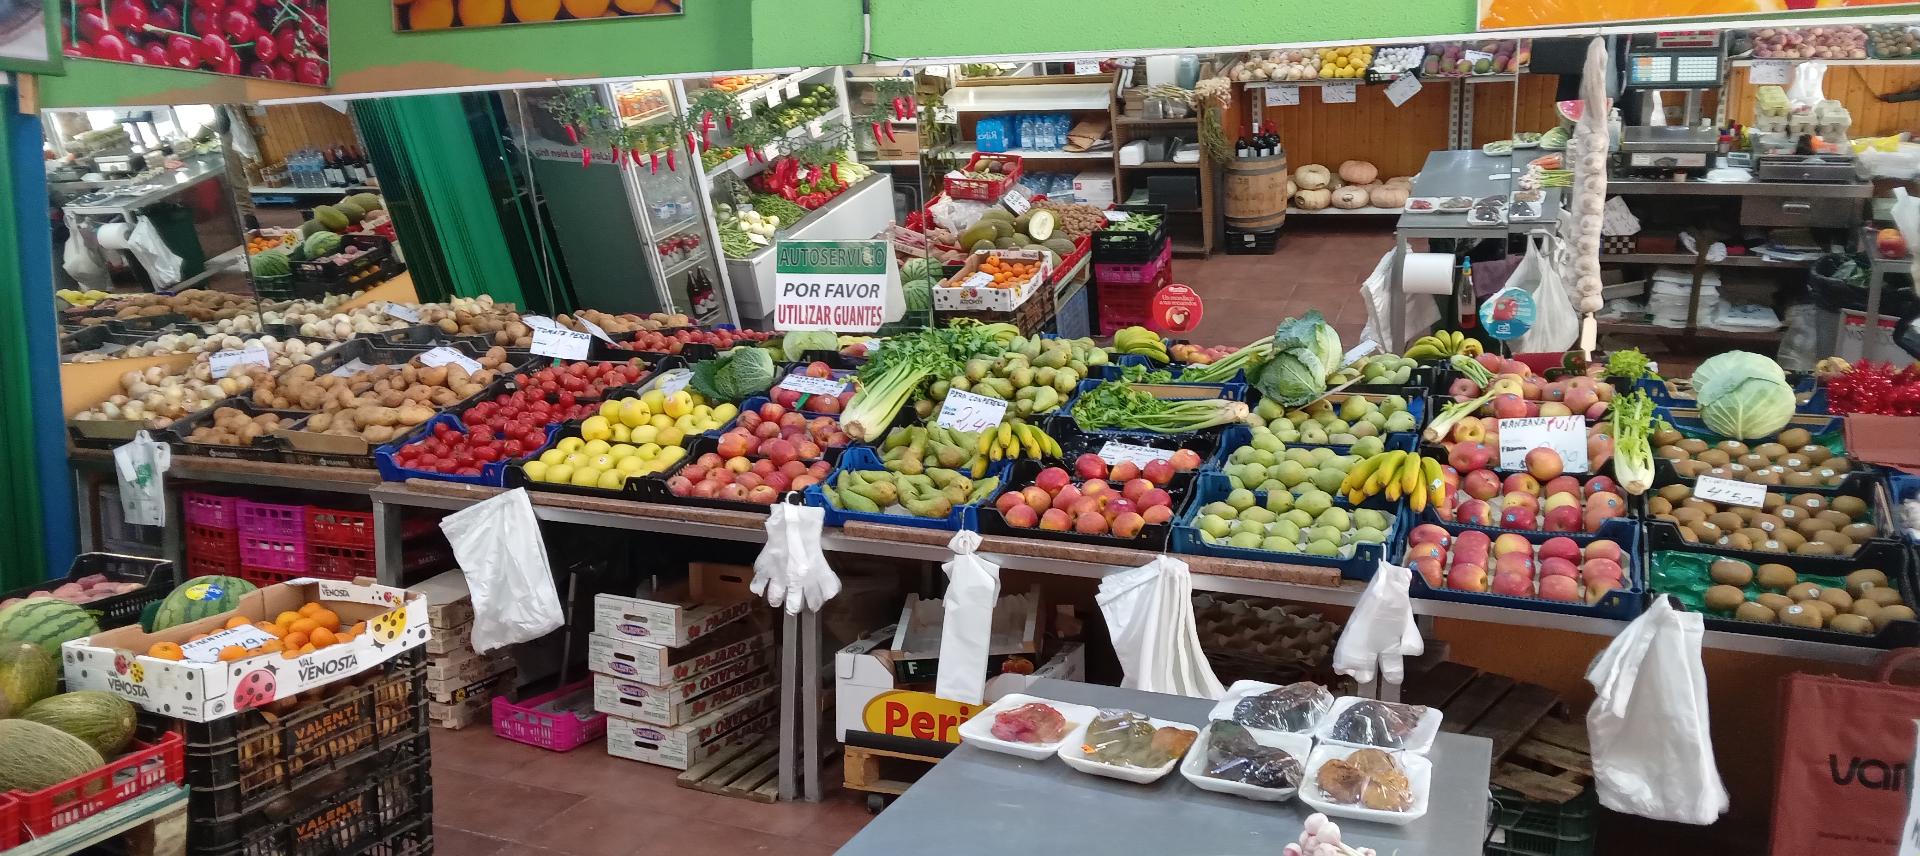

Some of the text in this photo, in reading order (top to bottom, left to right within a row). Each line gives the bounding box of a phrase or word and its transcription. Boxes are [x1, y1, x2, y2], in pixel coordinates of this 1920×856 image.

[780, 247, 885, 267] AUTOSERVICIO
[783, 283, 880, 298] POR FAVOR
[778, 304, 882, 326] UTILIZAR GUANTES
[1501, 418, 1546, 430] MANZANA
[321, 589, 350, 598] VENOSTA
[704, 602, 749, 633] PAJARO
[298, 656, 314, 668] VAL
[695, 642, 747, 672] PAJARO
[298, 654, 358, 682] VENOSTA
[908, 661, 918, 675] F
[108, 678, 149, 698] VENOSTA
